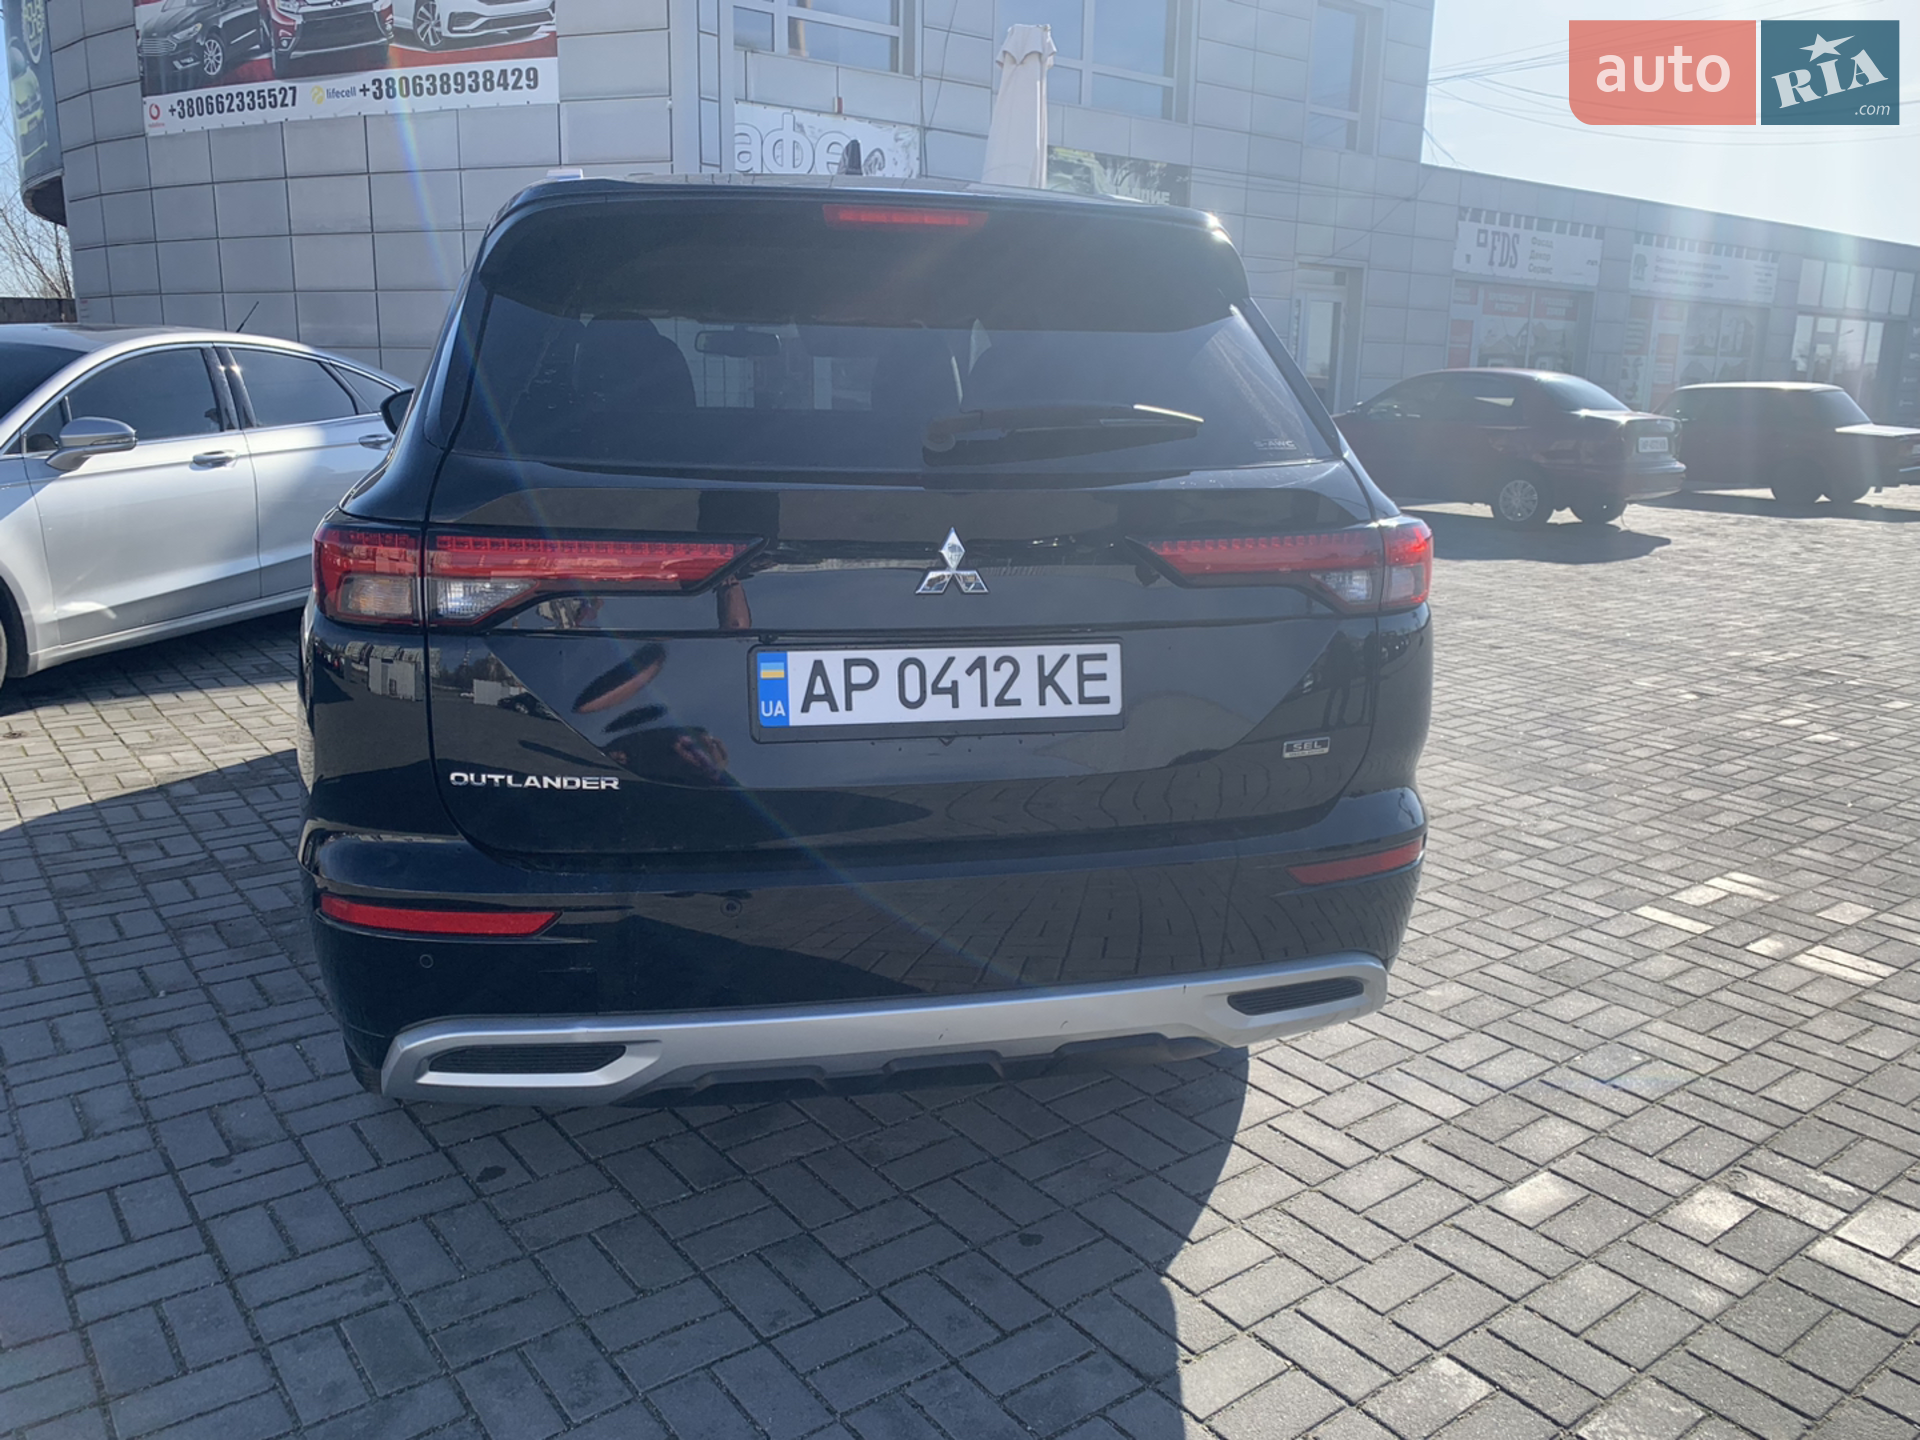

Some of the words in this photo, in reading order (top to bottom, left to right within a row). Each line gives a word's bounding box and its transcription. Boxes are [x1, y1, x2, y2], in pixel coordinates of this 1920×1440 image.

[168, 86, 298, 120] +380662335527
[326, 86, 357, 99] lifecell
[359, 66, 539, 100] +380638938429
[1488, 230, 1520, 269] FDS
[800, 658, 879, 713] AP
[897, 655, 1022, 710] 0412
[1037, 653, 1111, 706] KE
[761, 701, 786, 717] UA
[1293, 741, 1321, 752] SEL
[449, 772, 620, 790] OUTLANDER
